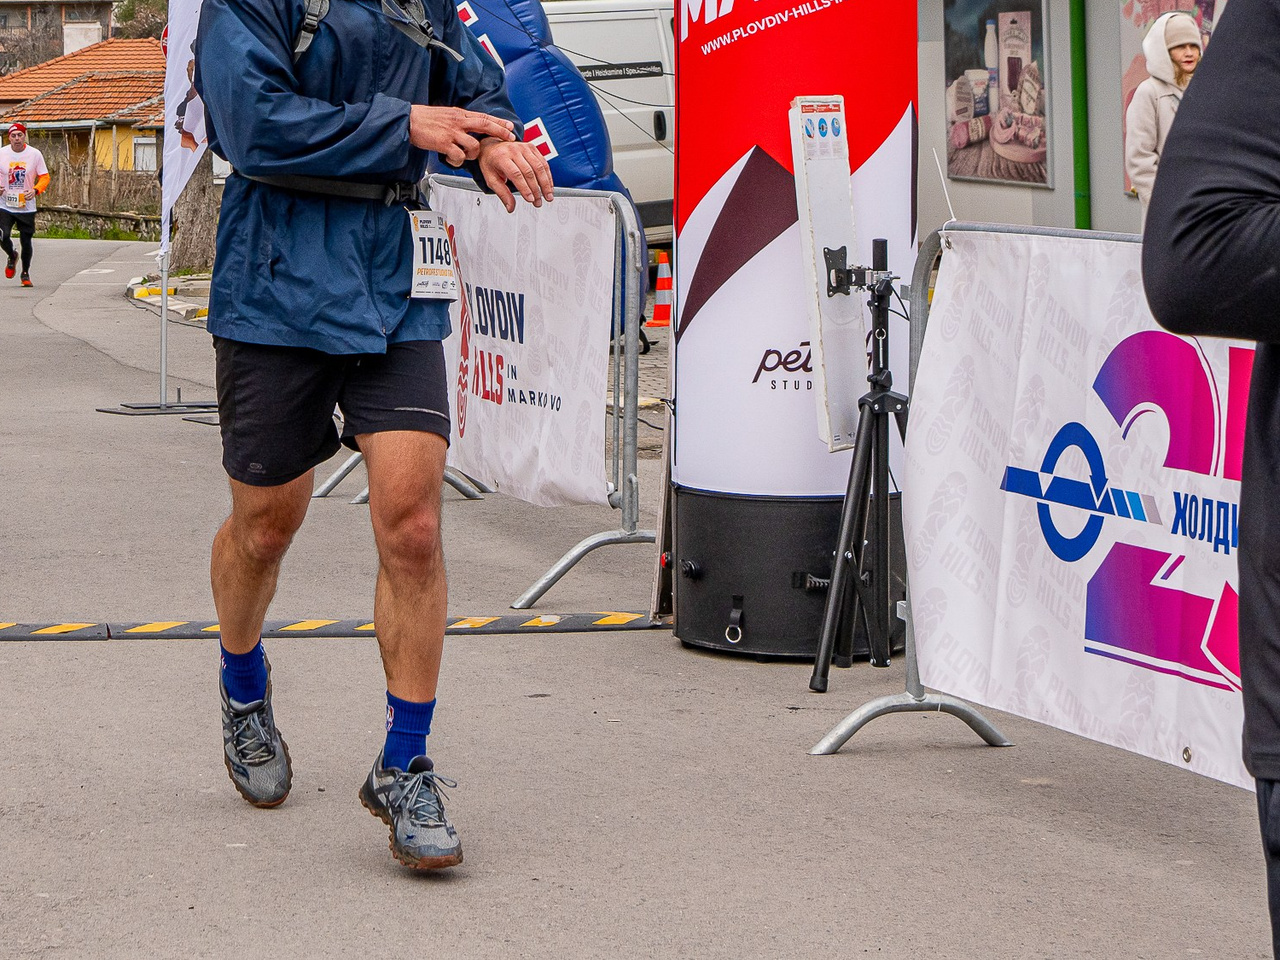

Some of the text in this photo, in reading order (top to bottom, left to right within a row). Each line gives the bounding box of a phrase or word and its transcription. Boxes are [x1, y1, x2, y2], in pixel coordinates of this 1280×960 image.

[419, 237, 451, 266] 1148
[507, 363, 518, 380] IN
[771, 380, 813, 390] STUD
[507, 387, 562, 412] MARKOVO
